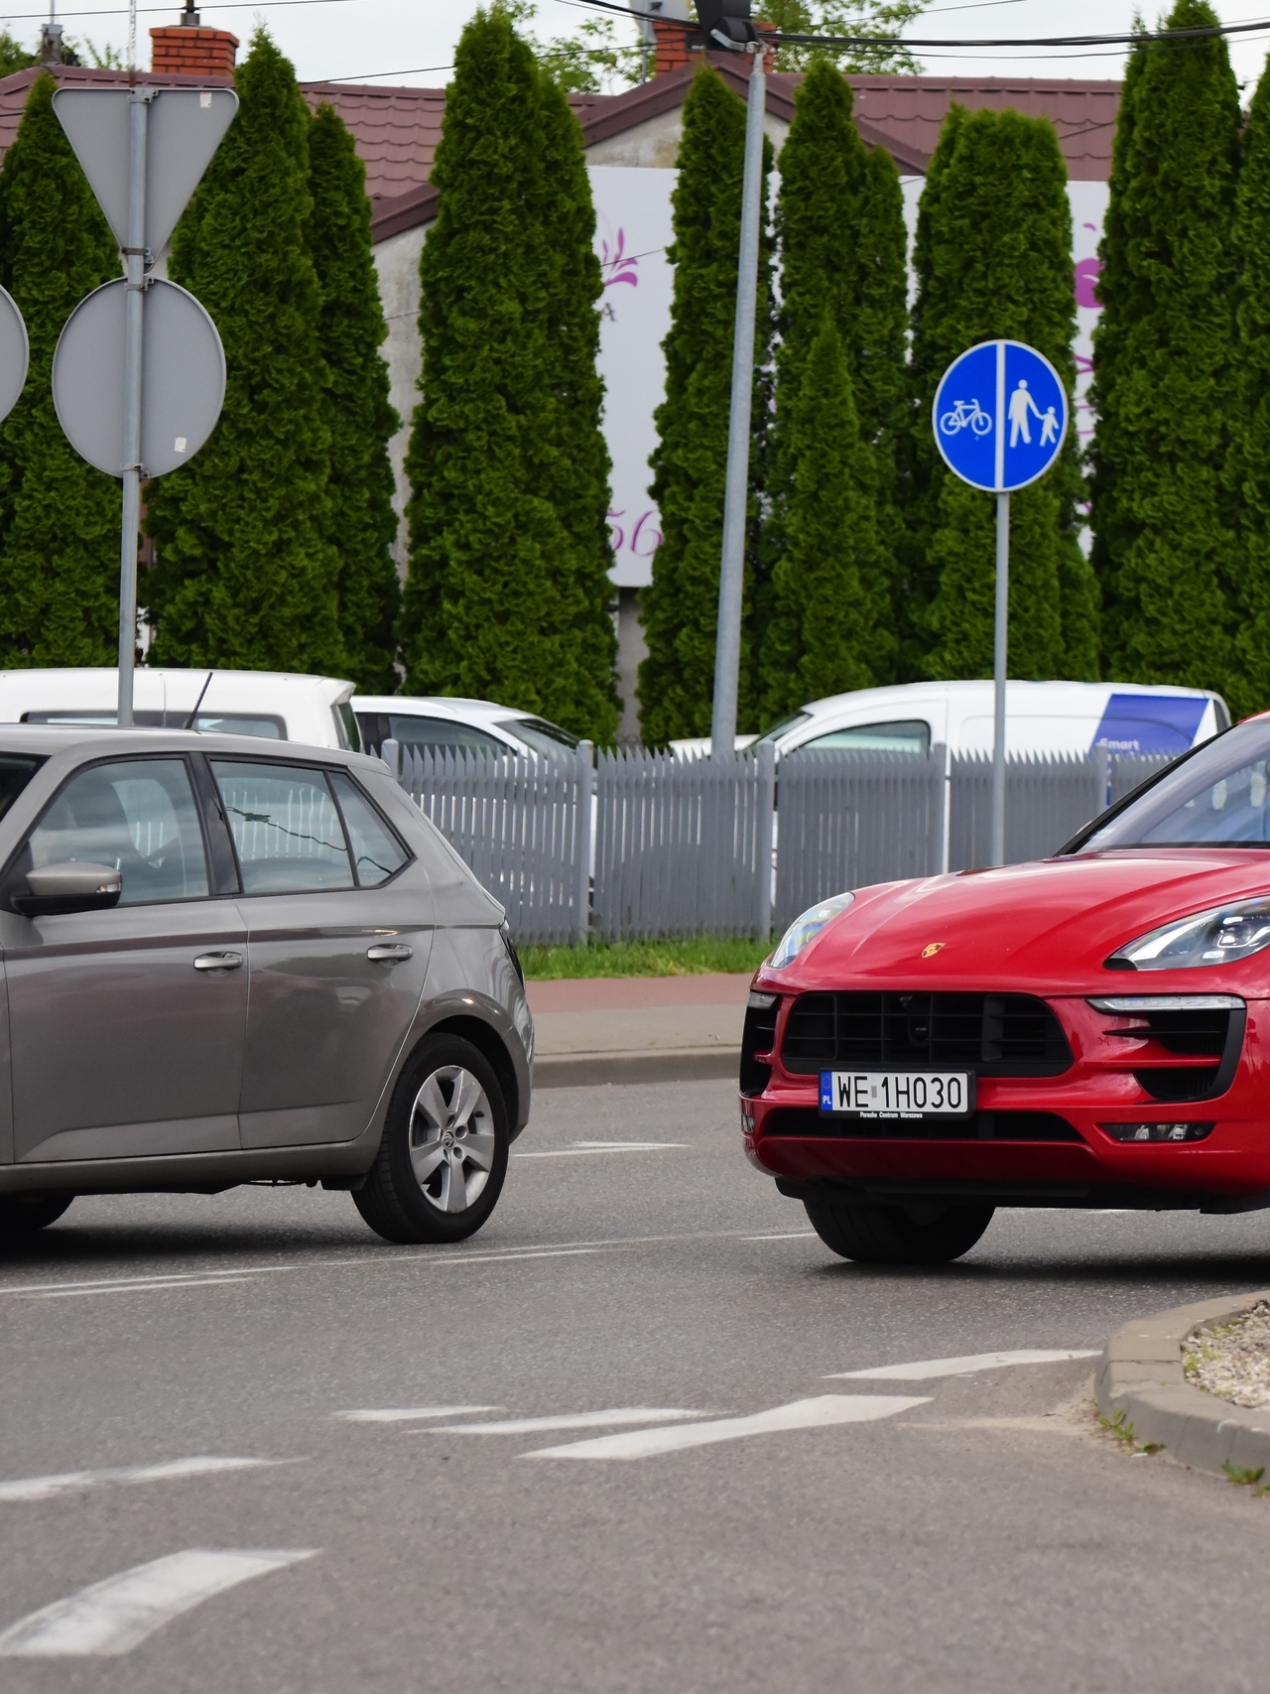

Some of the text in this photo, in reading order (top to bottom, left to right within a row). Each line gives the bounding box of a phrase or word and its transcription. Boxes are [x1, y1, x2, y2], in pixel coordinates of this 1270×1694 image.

[822, 1095, 832, 1105] PL
[837, 1075, 962, 1109] WE 1H030
